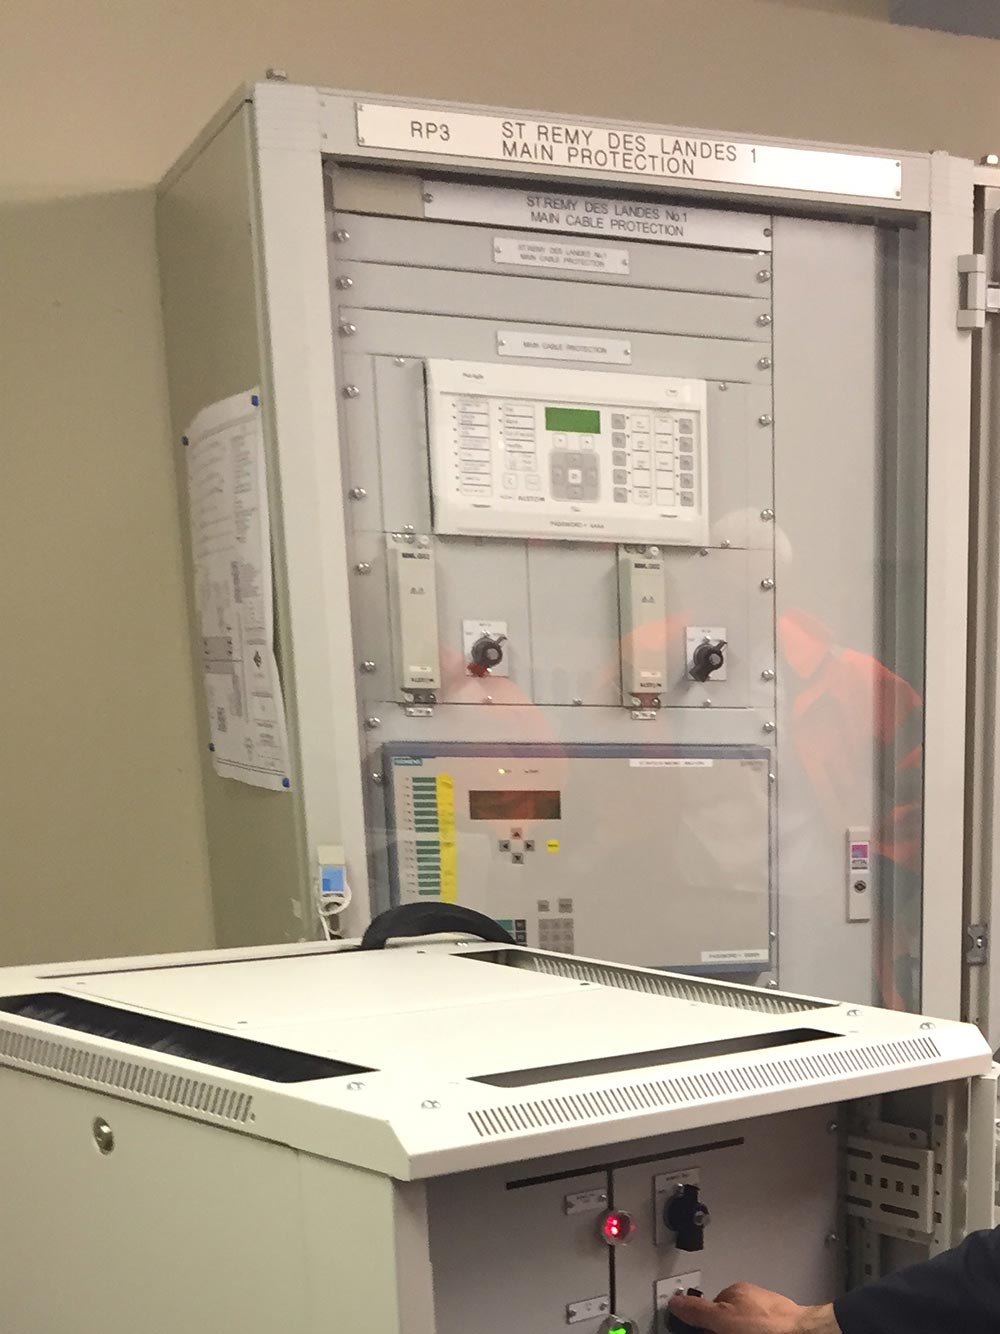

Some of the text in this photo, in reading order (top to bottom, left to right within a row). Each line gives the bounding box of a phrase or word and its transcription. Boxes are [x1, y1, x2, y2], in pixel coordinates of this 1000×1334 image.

[410, 120, 450, 141] RP3
[502, 121, 757, 163] ST REMY DES LANDES 1
[502, 141, 694, 175] MAIN PROTECTION
[584, 201, 609, 215] DES
[614, 204, 660, 220] LANDES
[531, 211, 684, 236] MAIN CABLE PROTECTION
